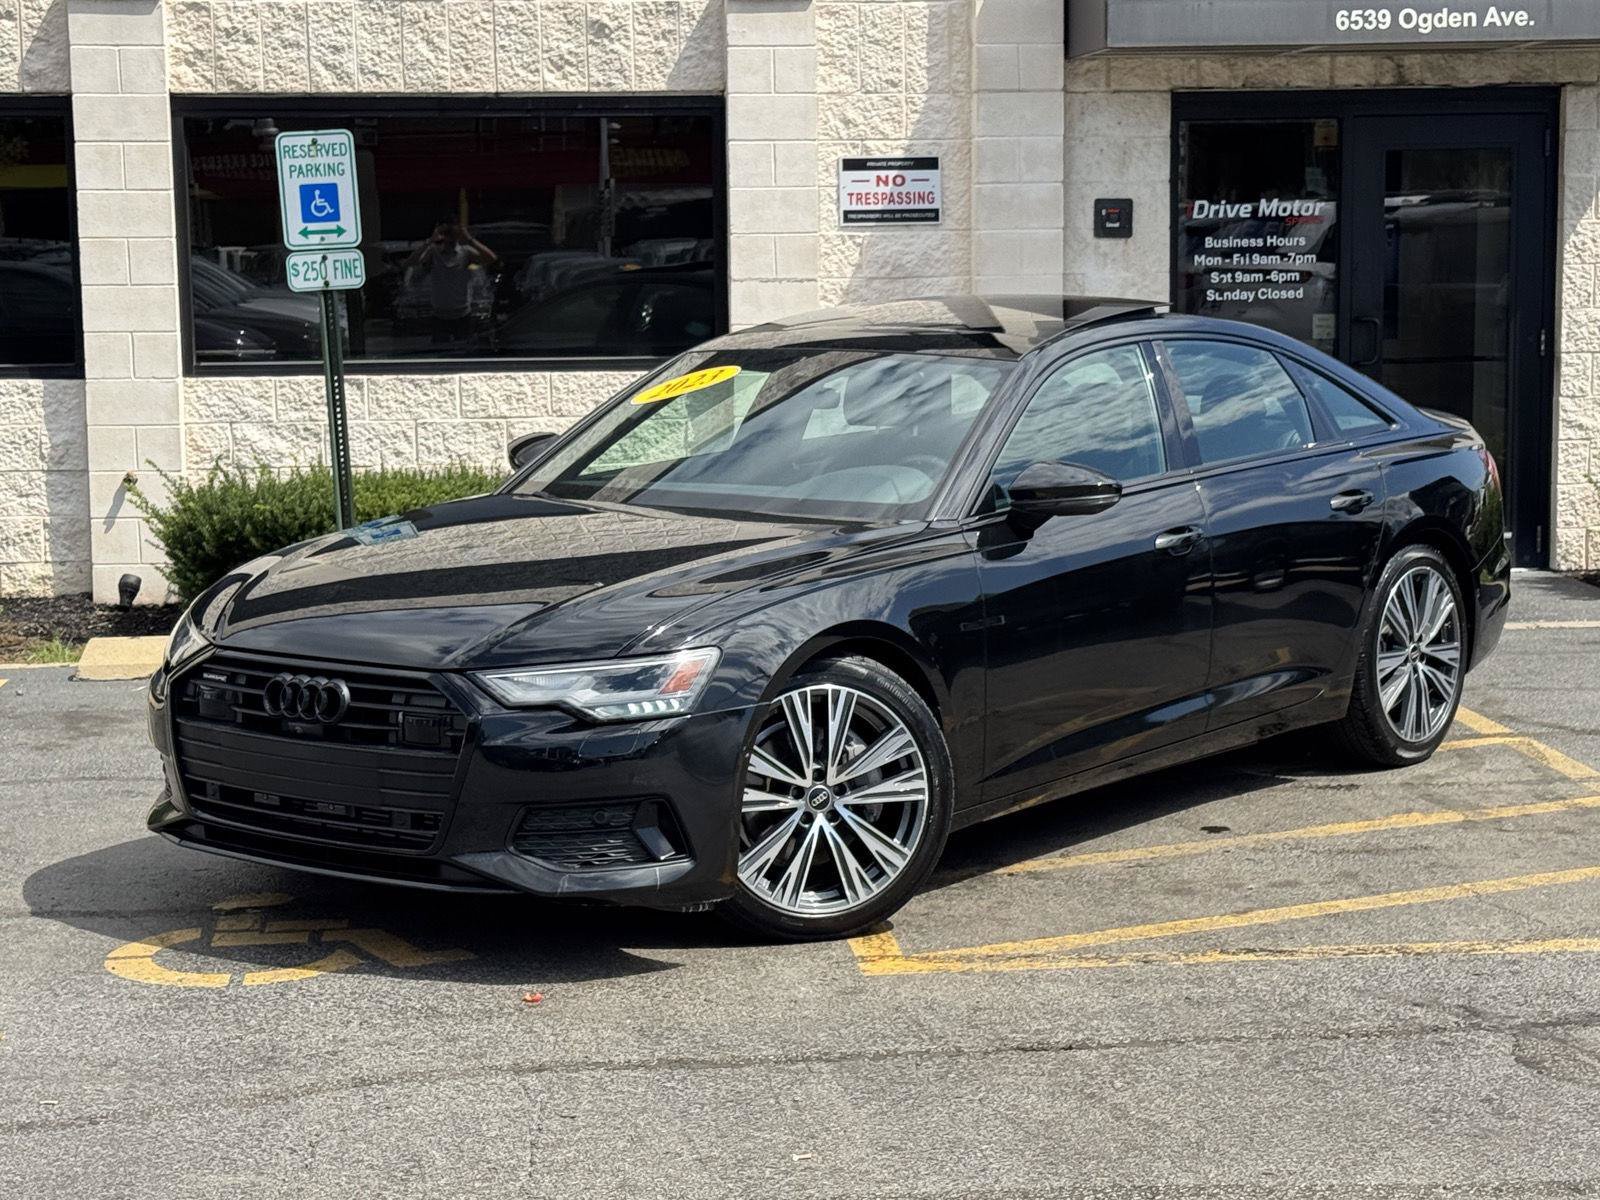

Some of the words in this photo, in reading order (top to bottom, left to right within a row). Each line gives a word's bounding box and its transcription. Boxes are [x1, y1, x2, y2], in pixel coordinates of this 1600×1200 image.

[1335, 8, 1391, 31] 6539
[1398, 7, 1477, 34] Ogden
[1482, 6, 1535, 27] Ave.
[282, 142, 348, 159] RESERVED
[288, 162, 346, 179] PARKING
[875, 174, 906, 187] NO
[847, 191, 935, 206] TRESPASSING
[1192, 199, 1252, 219] Drive
[1258, 198, 1326, 217] Motor
[1204, 236, 1264, 248] Business
[1266, 235, 1306, 247] Hours
[1194, 254, 1222, 266] Mon
[1252, 254, 1280, 265] 9am
[333, 258, 362, 280] FINE
[1235, 271, 1263, 282] 9am
[1257, 287, 1304, 299] Closed
